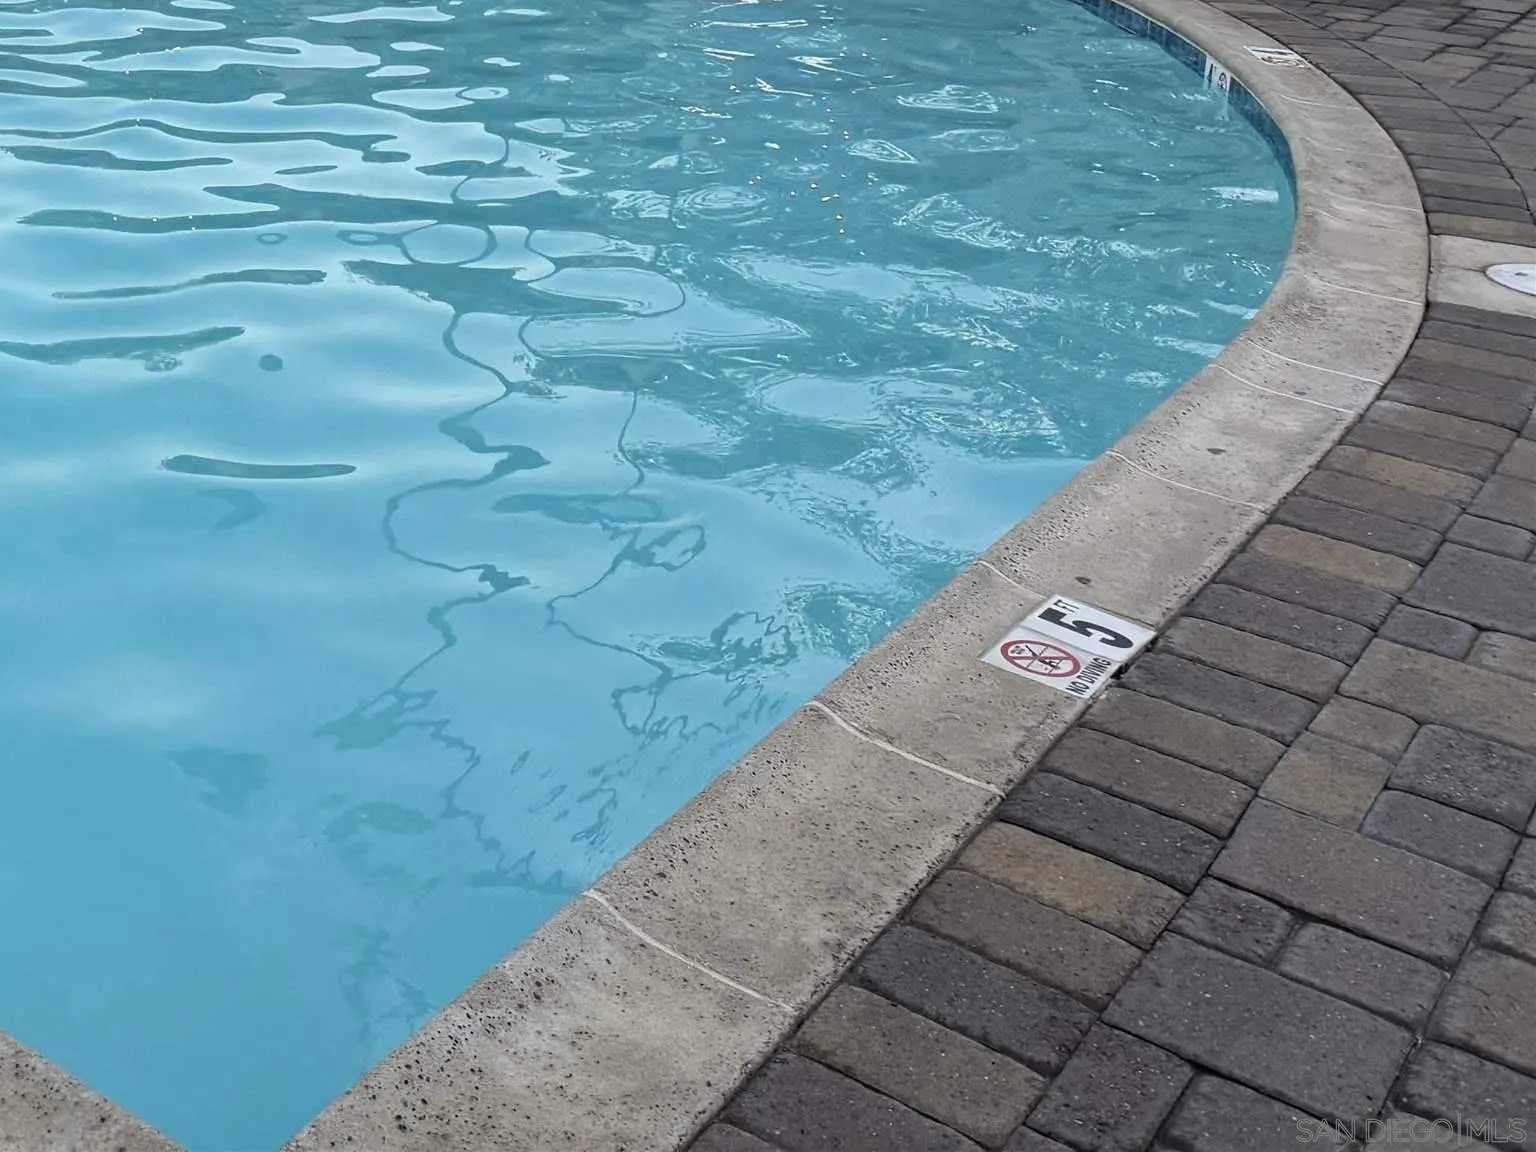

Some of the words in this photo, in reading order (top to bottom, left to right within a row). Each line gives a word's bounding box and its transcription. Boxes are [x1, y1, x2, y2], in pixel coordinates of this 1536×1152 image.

[1053, 599, 1080, 613] FT
[1037, 607, 1134, 649] 5
[1065, 675, 1086, 696] NO
[1080, 657, 1112, 685] DIVING
